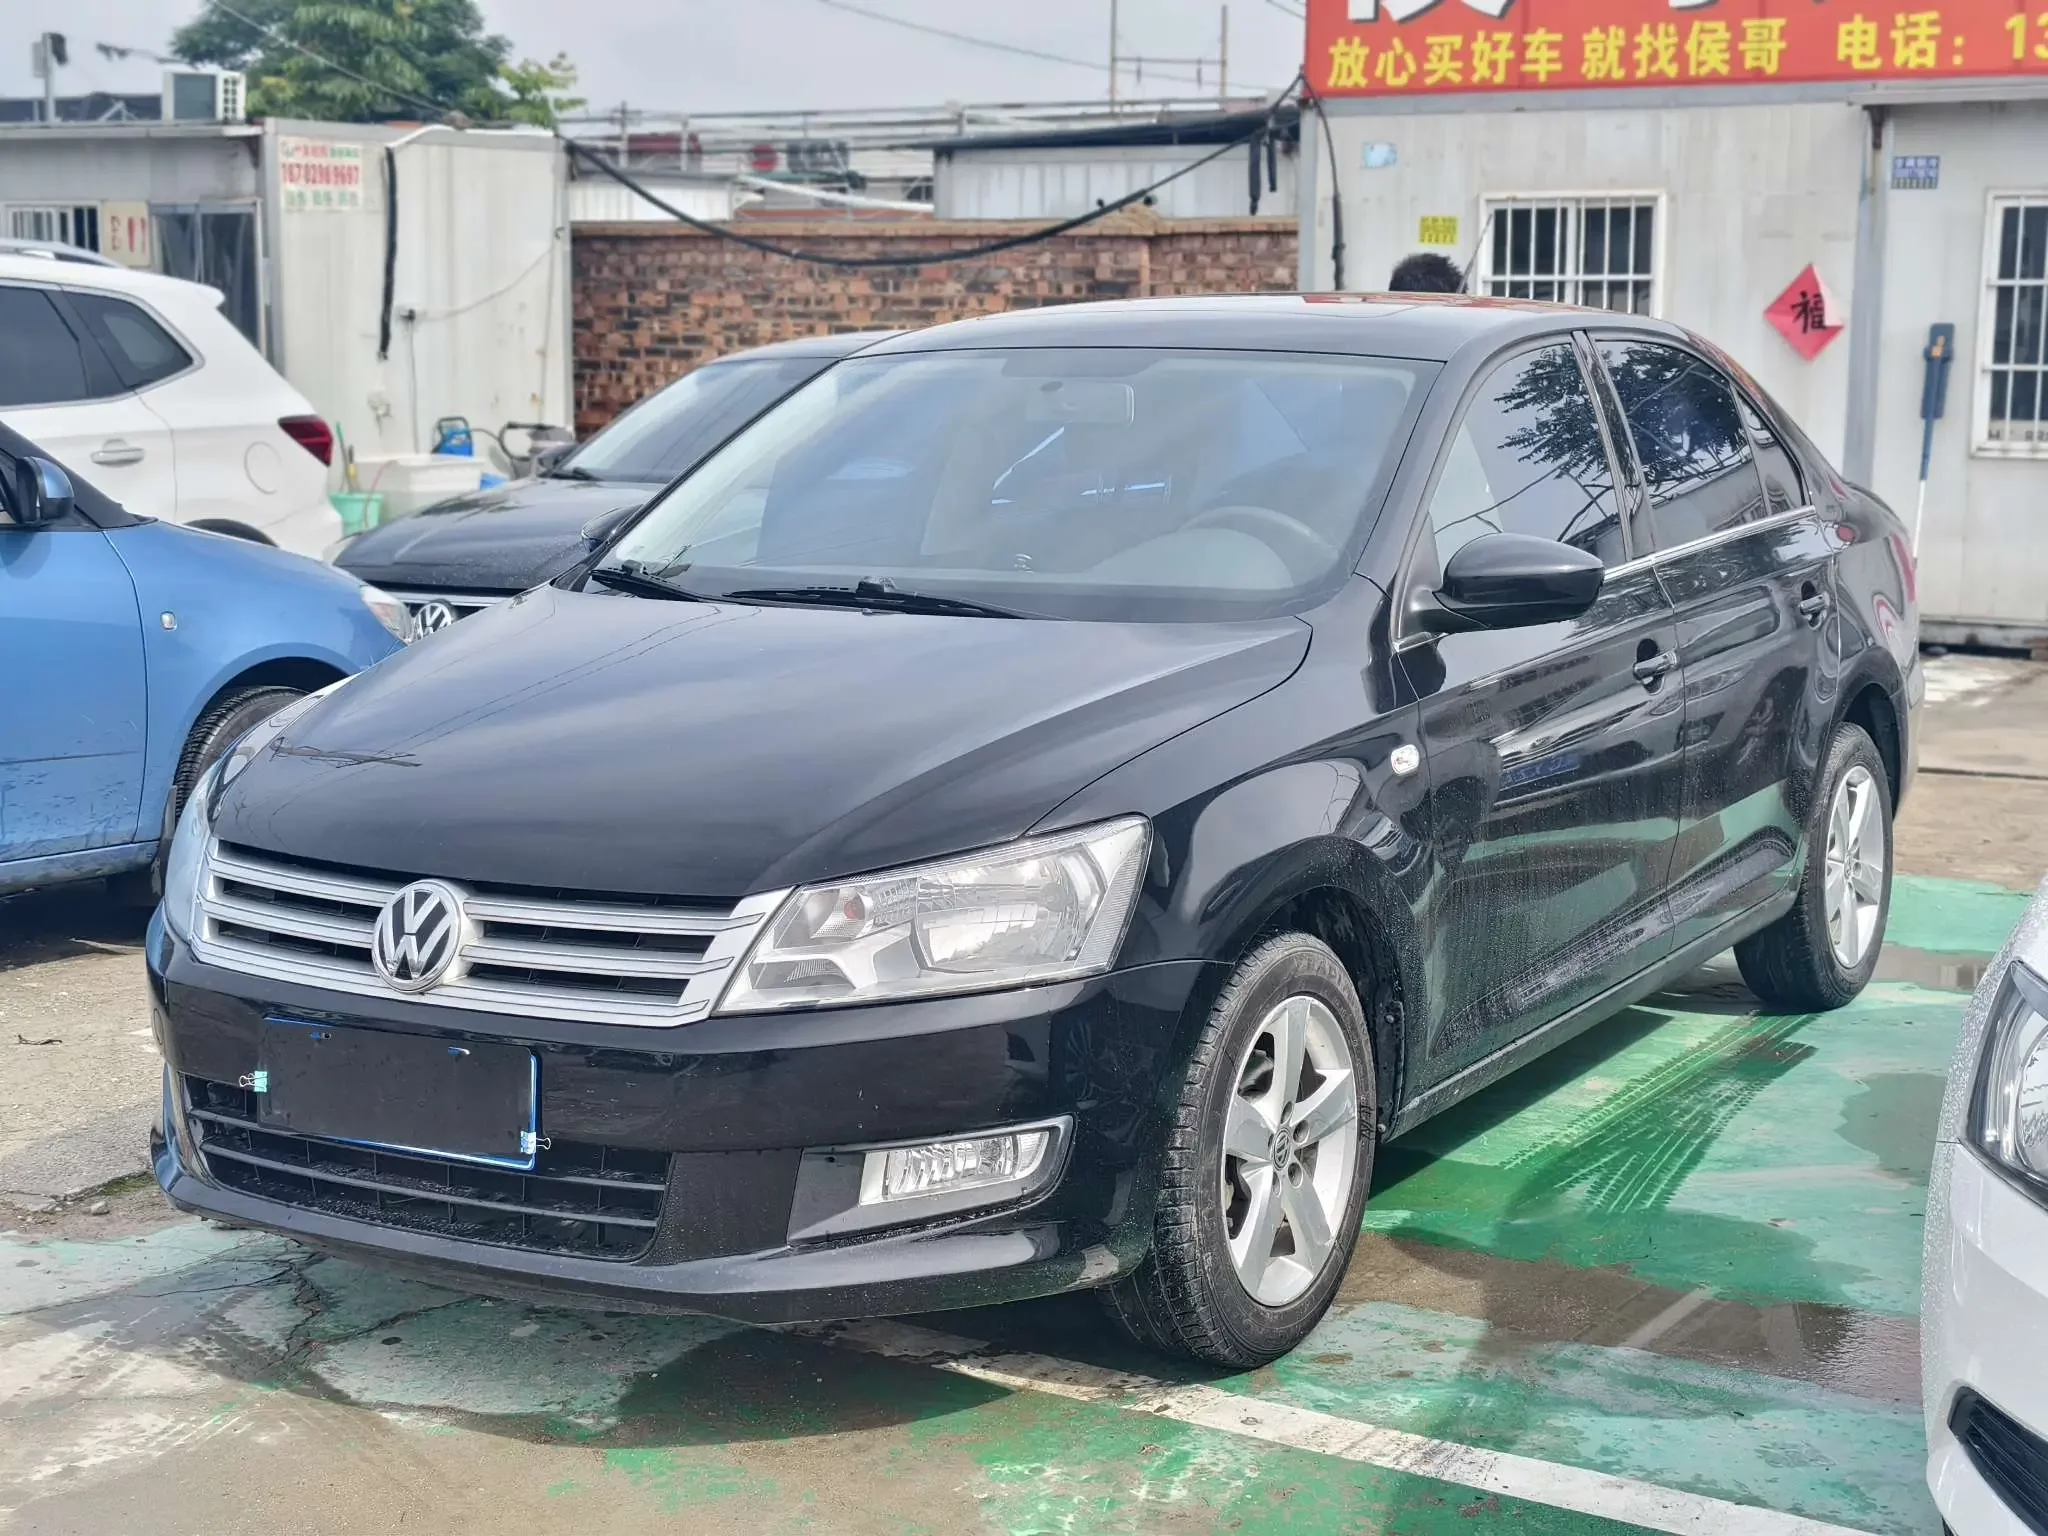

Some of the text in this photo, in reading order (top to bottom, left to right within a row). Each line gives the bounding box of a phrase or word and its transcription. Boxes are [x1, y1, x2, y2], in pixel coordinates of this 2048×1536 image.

[1327, 27, 1564, 89] 放心买好车
[1580, 18, 1788, 81] 就找侯哥
